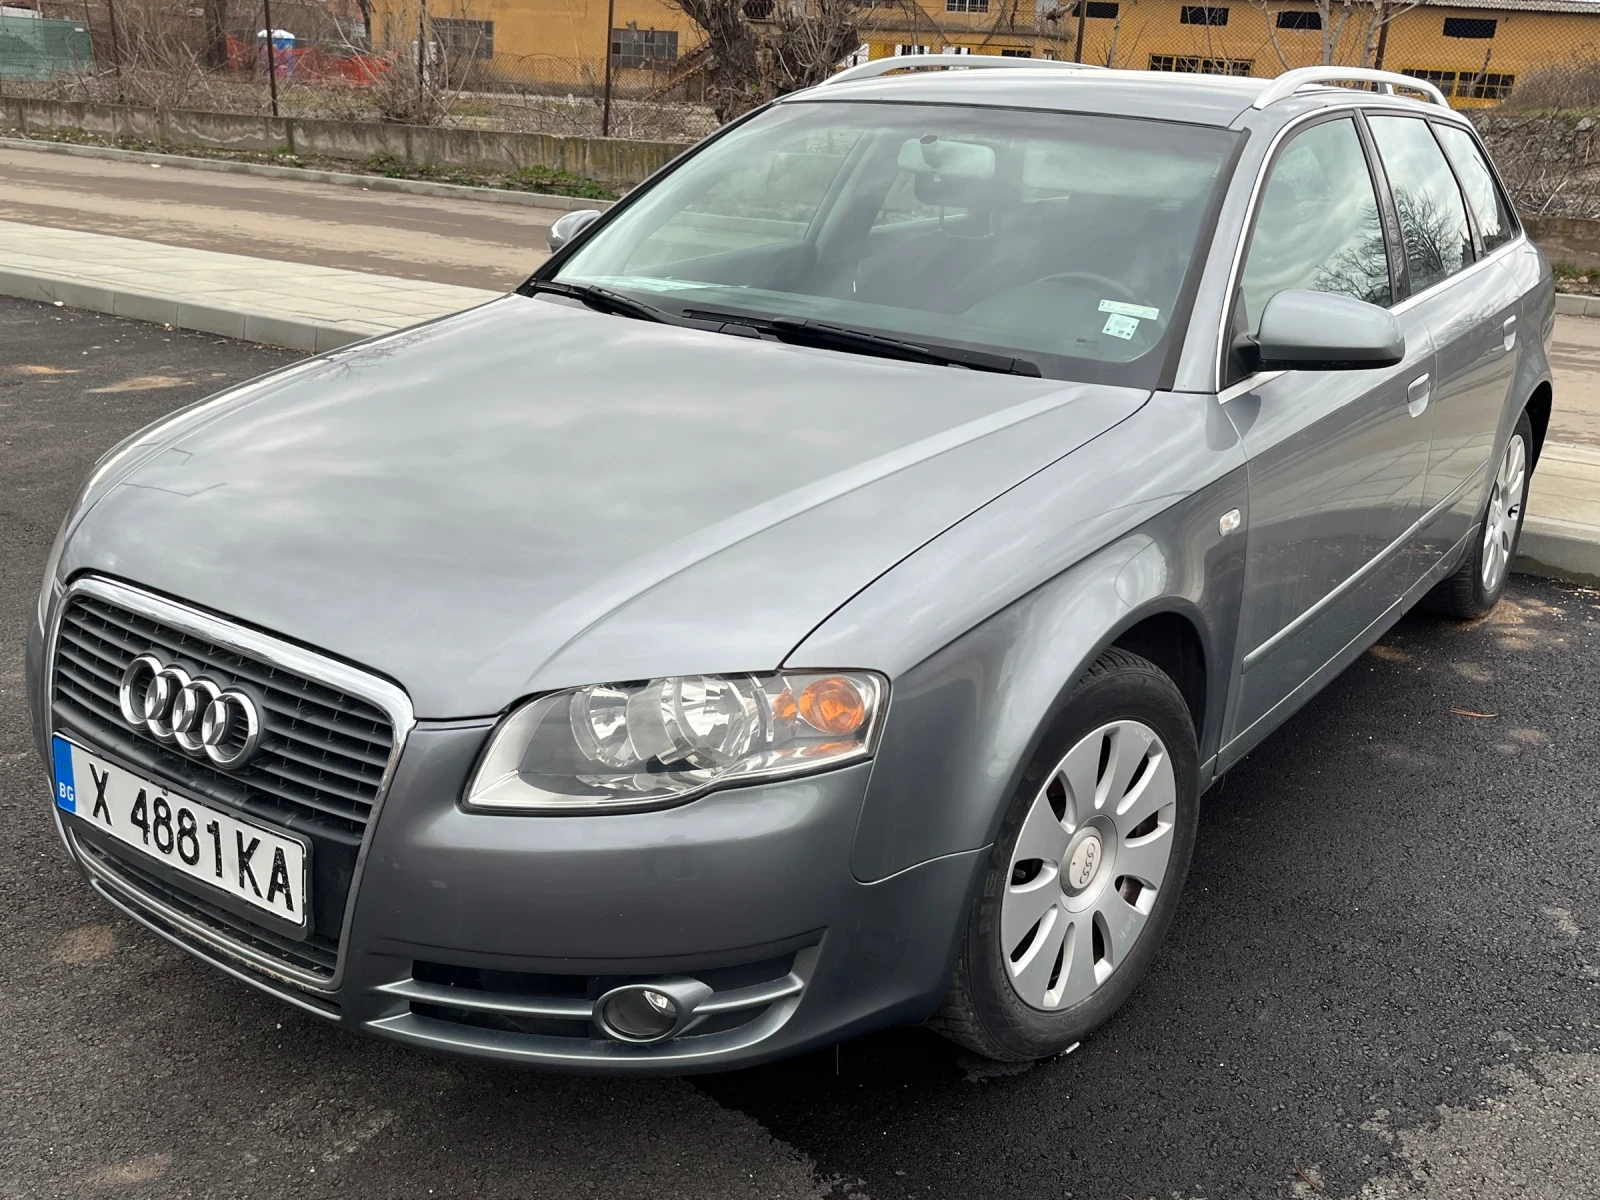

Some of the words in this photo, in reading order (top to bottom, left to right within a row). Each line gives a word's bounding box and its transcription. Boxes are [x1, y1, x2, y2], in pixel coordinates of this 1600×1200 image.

[58, 781, 75, 802] BG
[89, 761, 113, 826] X
[130, 786, 223, 879] 4881
[235, 829, 295, 912] KA
